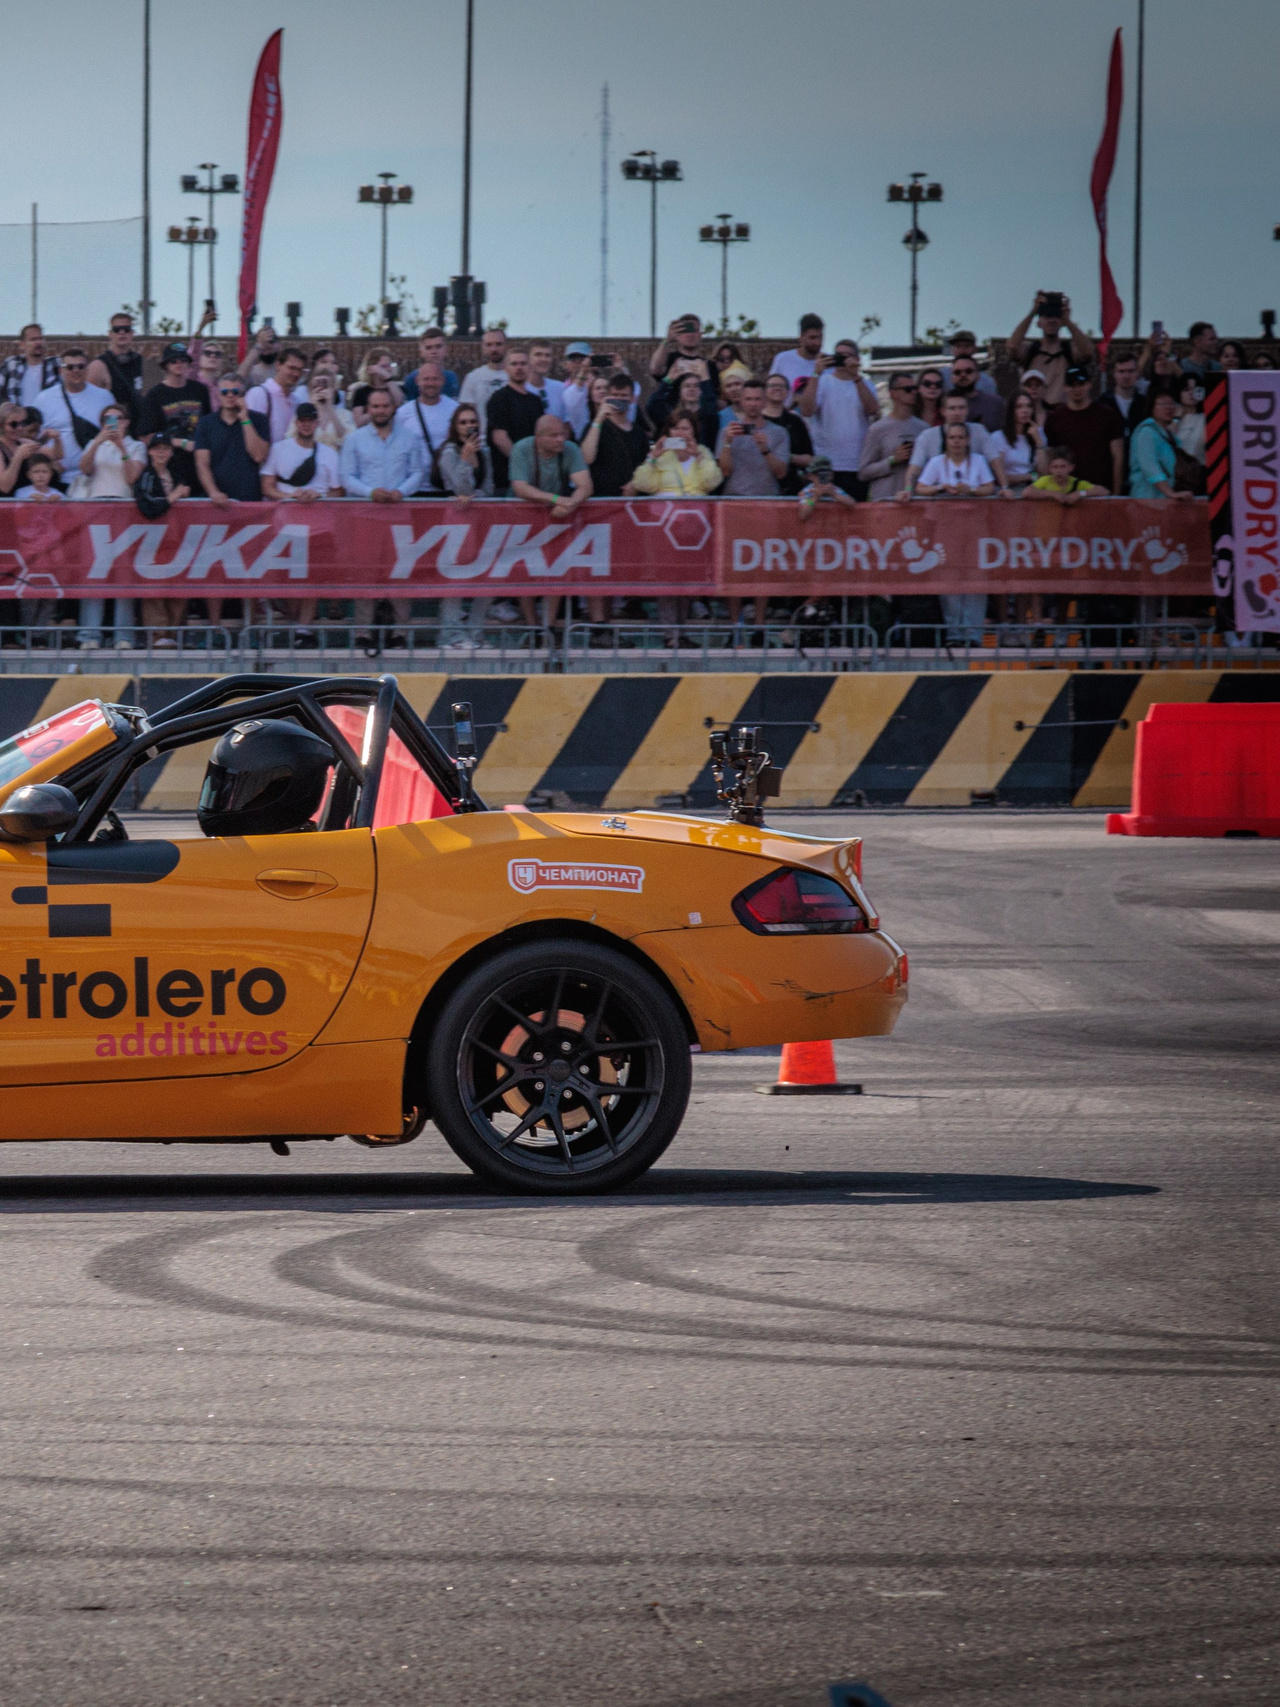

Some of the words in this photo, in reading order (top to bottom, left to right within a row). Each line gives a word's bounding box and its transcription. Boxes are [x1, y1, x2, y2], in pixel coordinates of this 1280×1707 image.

[1241, 390, 1279, 566] DRYDRY
[86, 524, 310, 580] YUKA
[388, 524, 613, 578] YUKA
[732, 538, 892, 572] DRYDRY
[977, 536, 1137, 570] DRYDRY
[539, 869, 638, 884] ЧЕМПИОНАТ
[94, 1021, 289, 1058] additives
